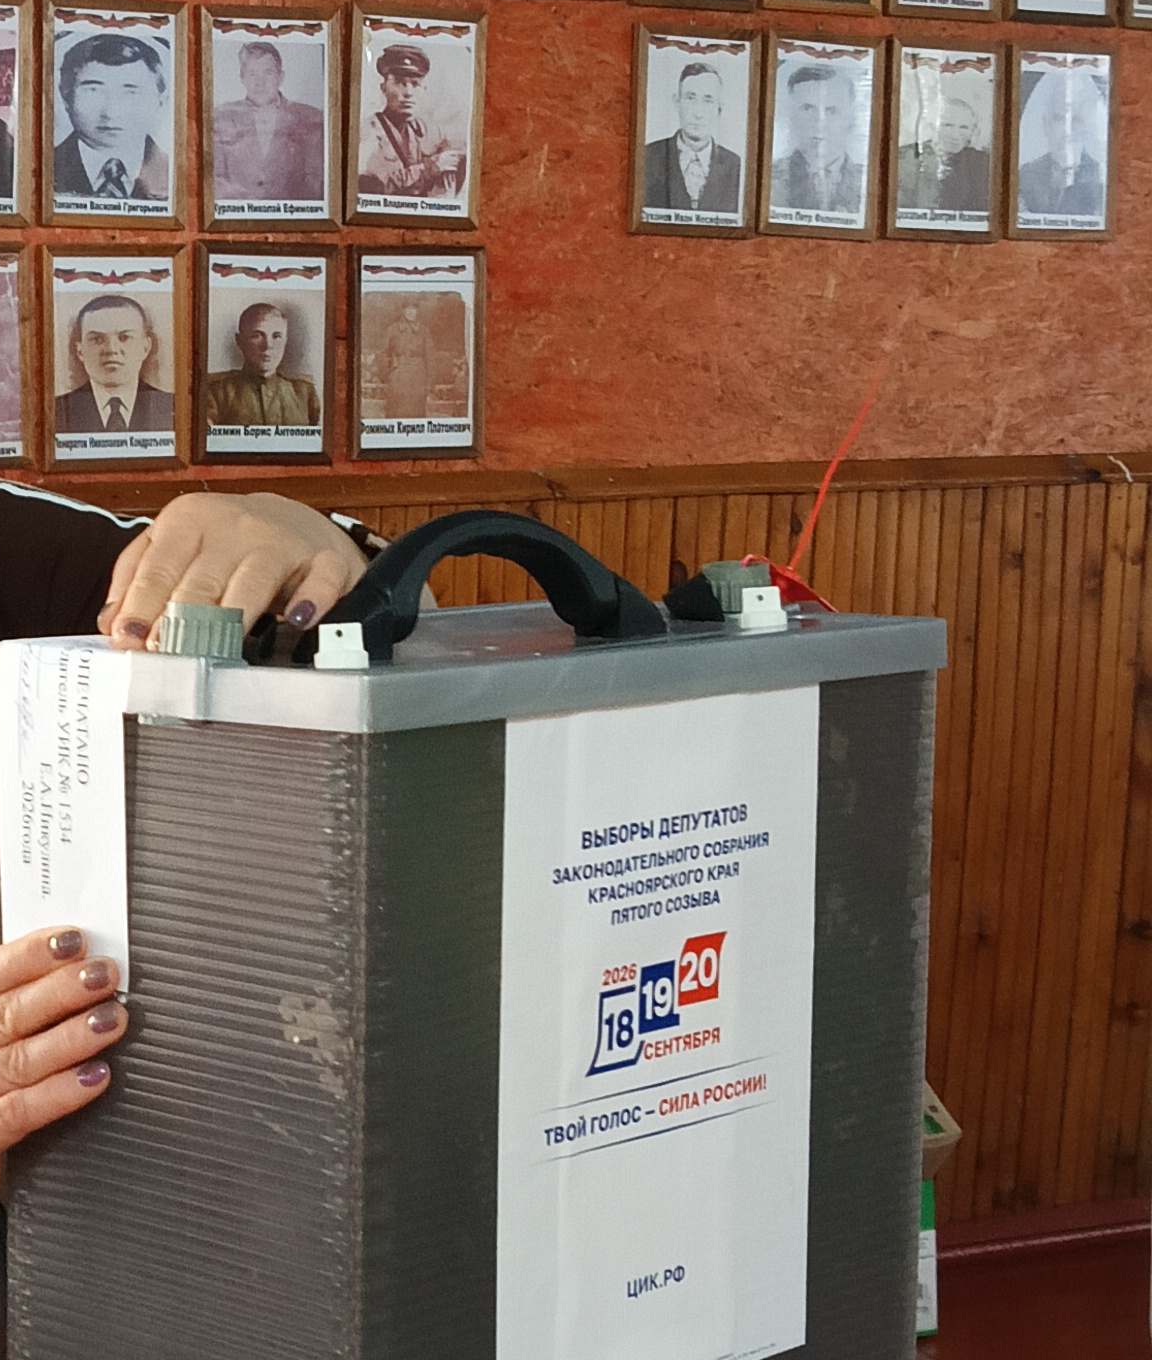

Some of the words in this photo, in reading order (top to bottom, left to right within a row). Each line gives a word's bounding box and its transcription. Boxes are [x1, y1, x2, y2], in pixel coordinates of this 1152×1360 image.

[57, 720, 72, 767] УИК
[57, 771, 71, 794] №
[57, 802, 73, 845] 1534
[581, 820, 654, 850] ВЫБОРЫ
[658, 803, 748, 839] ДЕПУТАТОВ
[552, 844, 700, 885] ЗАКОНОДАТЕЛЬНОГО
[703, 832, 770, 858] СОБРАНИЯ
[588, 868, 703, 904] КРАСНОЯРСКОГО
[707, 861, 740, 881] КРАЯ
[611, 900, 663, 926] ПЯТОГО
[665, 889, 721, 914] СОЗЫВА
[601, 963, 637, 987] 2026
[604, 1009, 635, 1051] 18
[641, 976, 673, 1020] 19
[679, 947, 718, 993] 20
[643, 1027, 721, 1061] СЕНТЯБРЯ
[544, 1114, 587, 1146] ТВОЙ
[590, 1105, 642, 1136] ГОЛОС
[659, 1090, 700, 1117] СИЛА
[703, 1073, 767, 1105] РОССИИ!
[626, 1265, 686, 1299] ЦИК.РФ
